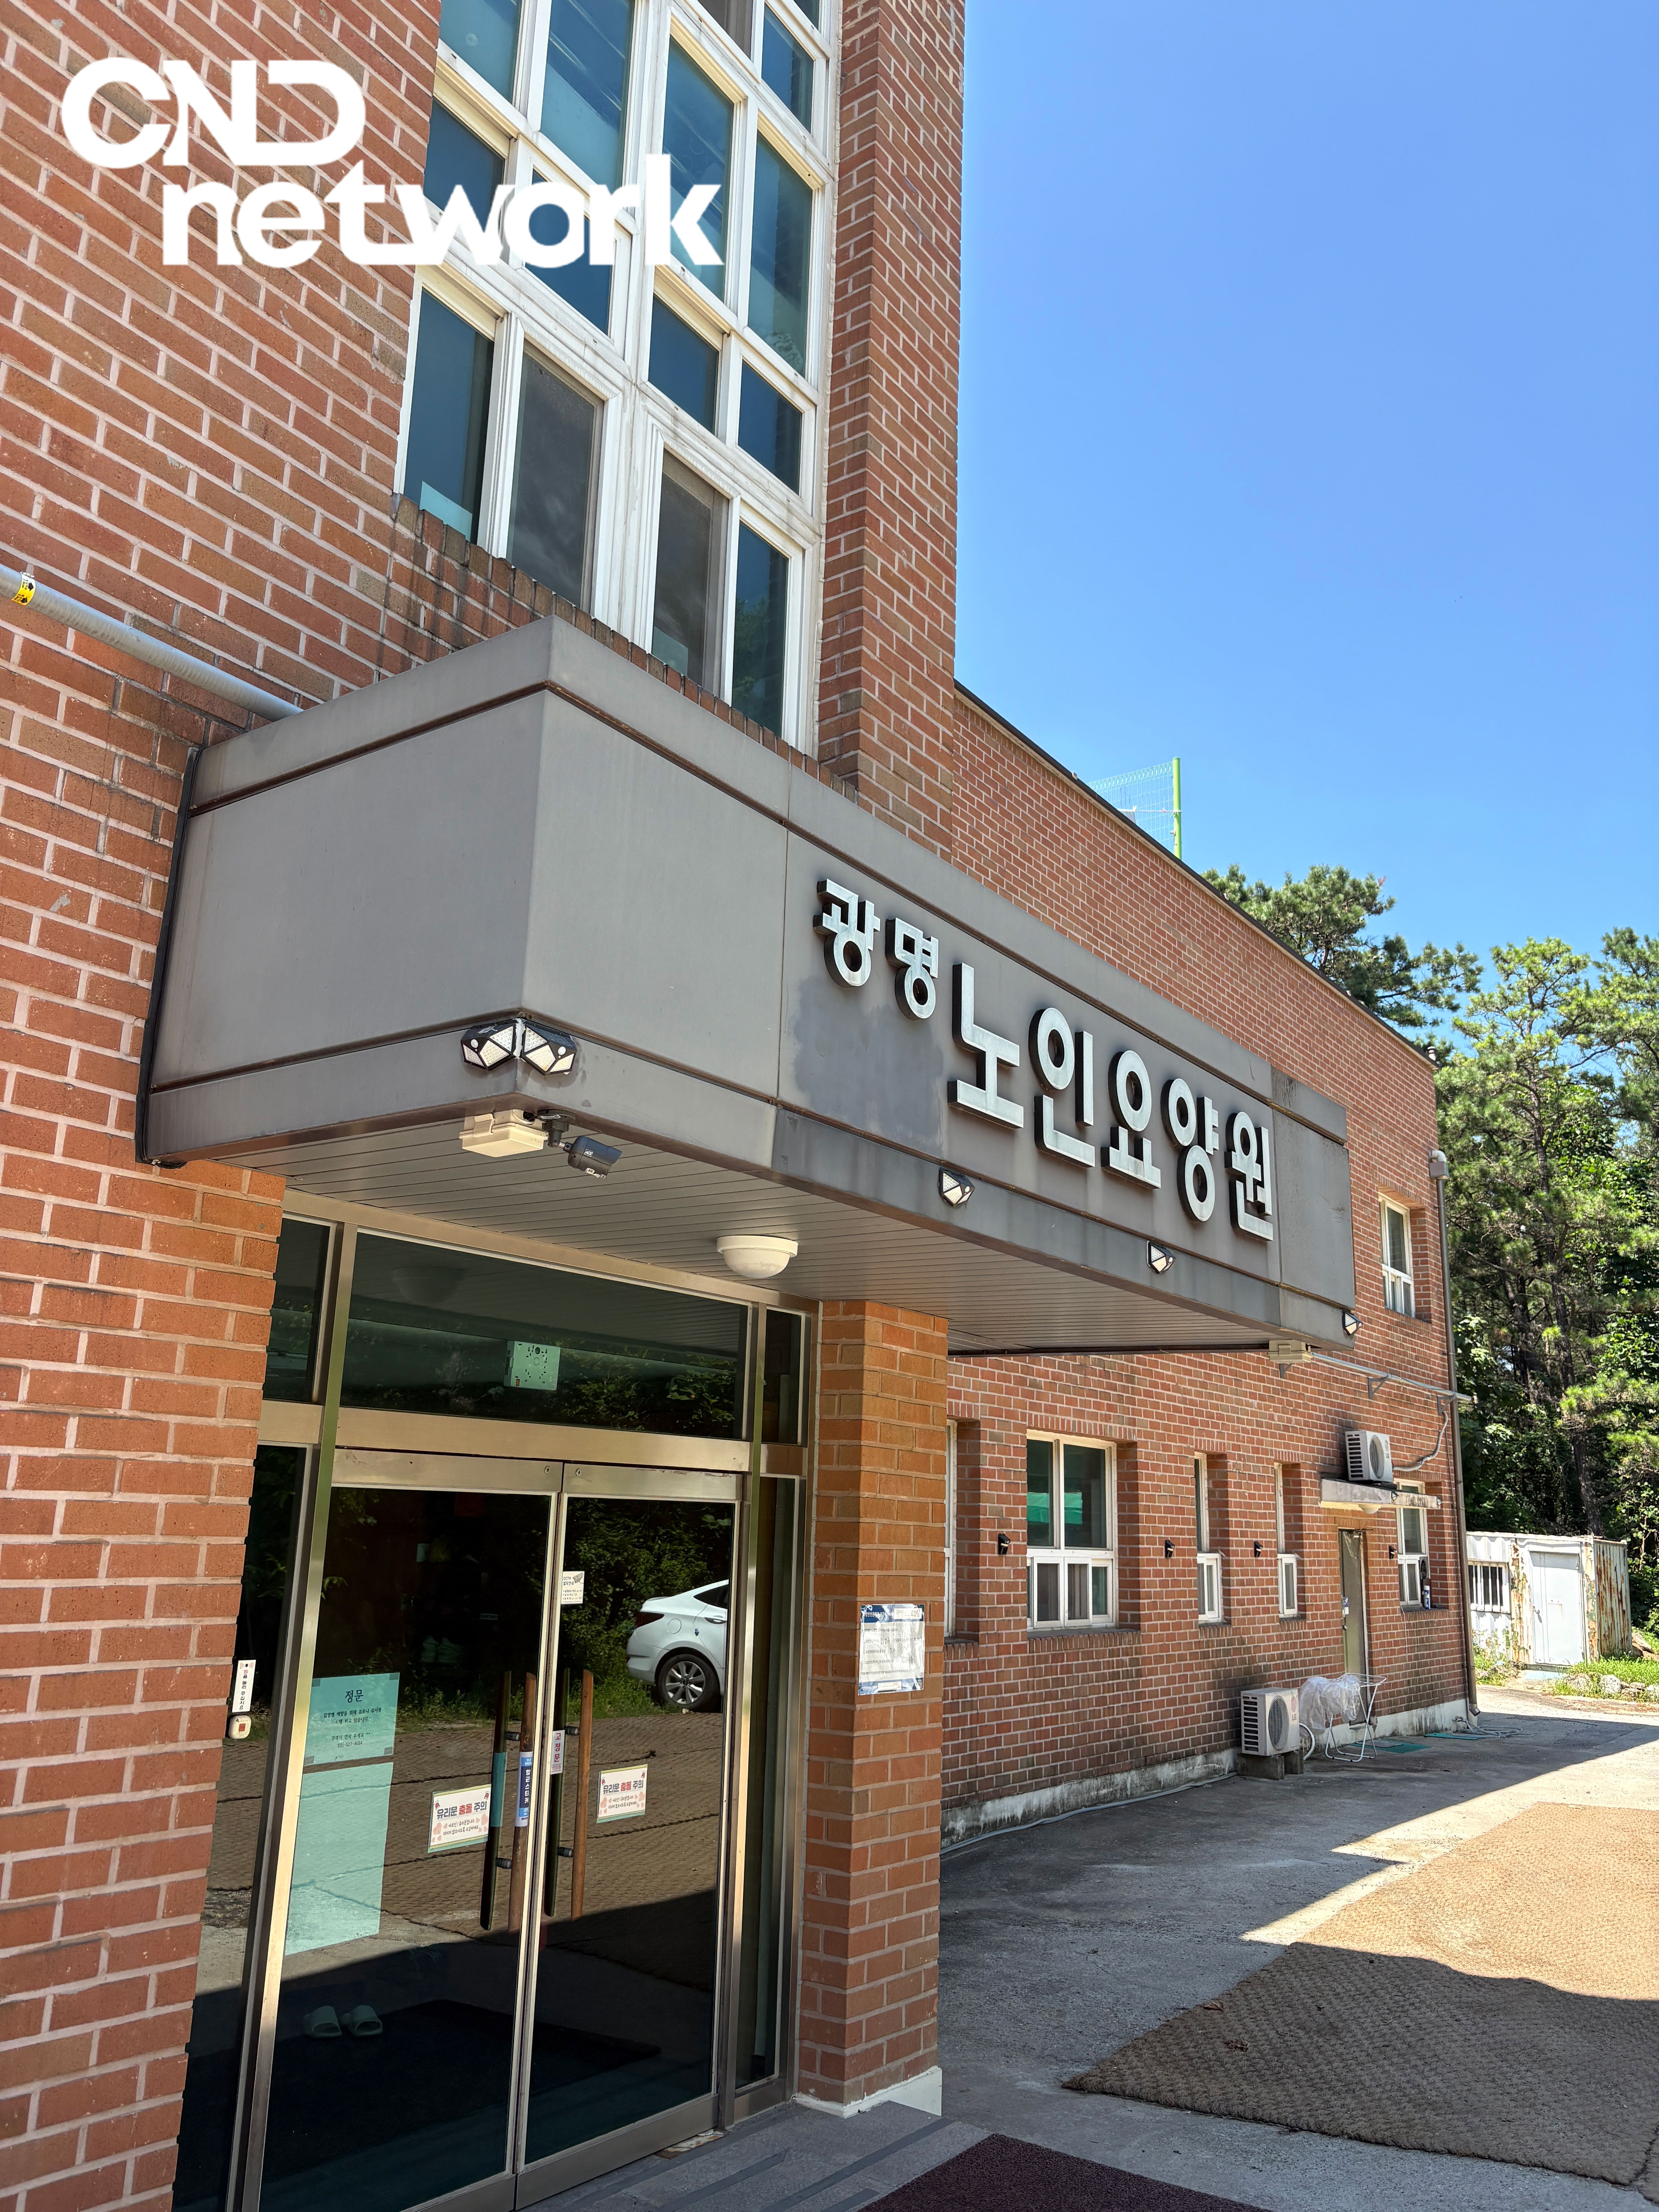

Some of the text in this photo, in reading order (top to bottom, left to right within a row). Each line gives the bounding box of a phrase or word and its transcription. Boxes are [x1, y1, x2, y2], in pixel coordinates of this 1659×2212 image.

[813, 878, 1274, 1241] 광명 노인요양원
[345, 1690, 364, 1703] 정문
[603, 1779, 644, 1794] 유리문 충돌 주의
[437, 1801, 487, 1819] 유리문 충돌 주의
